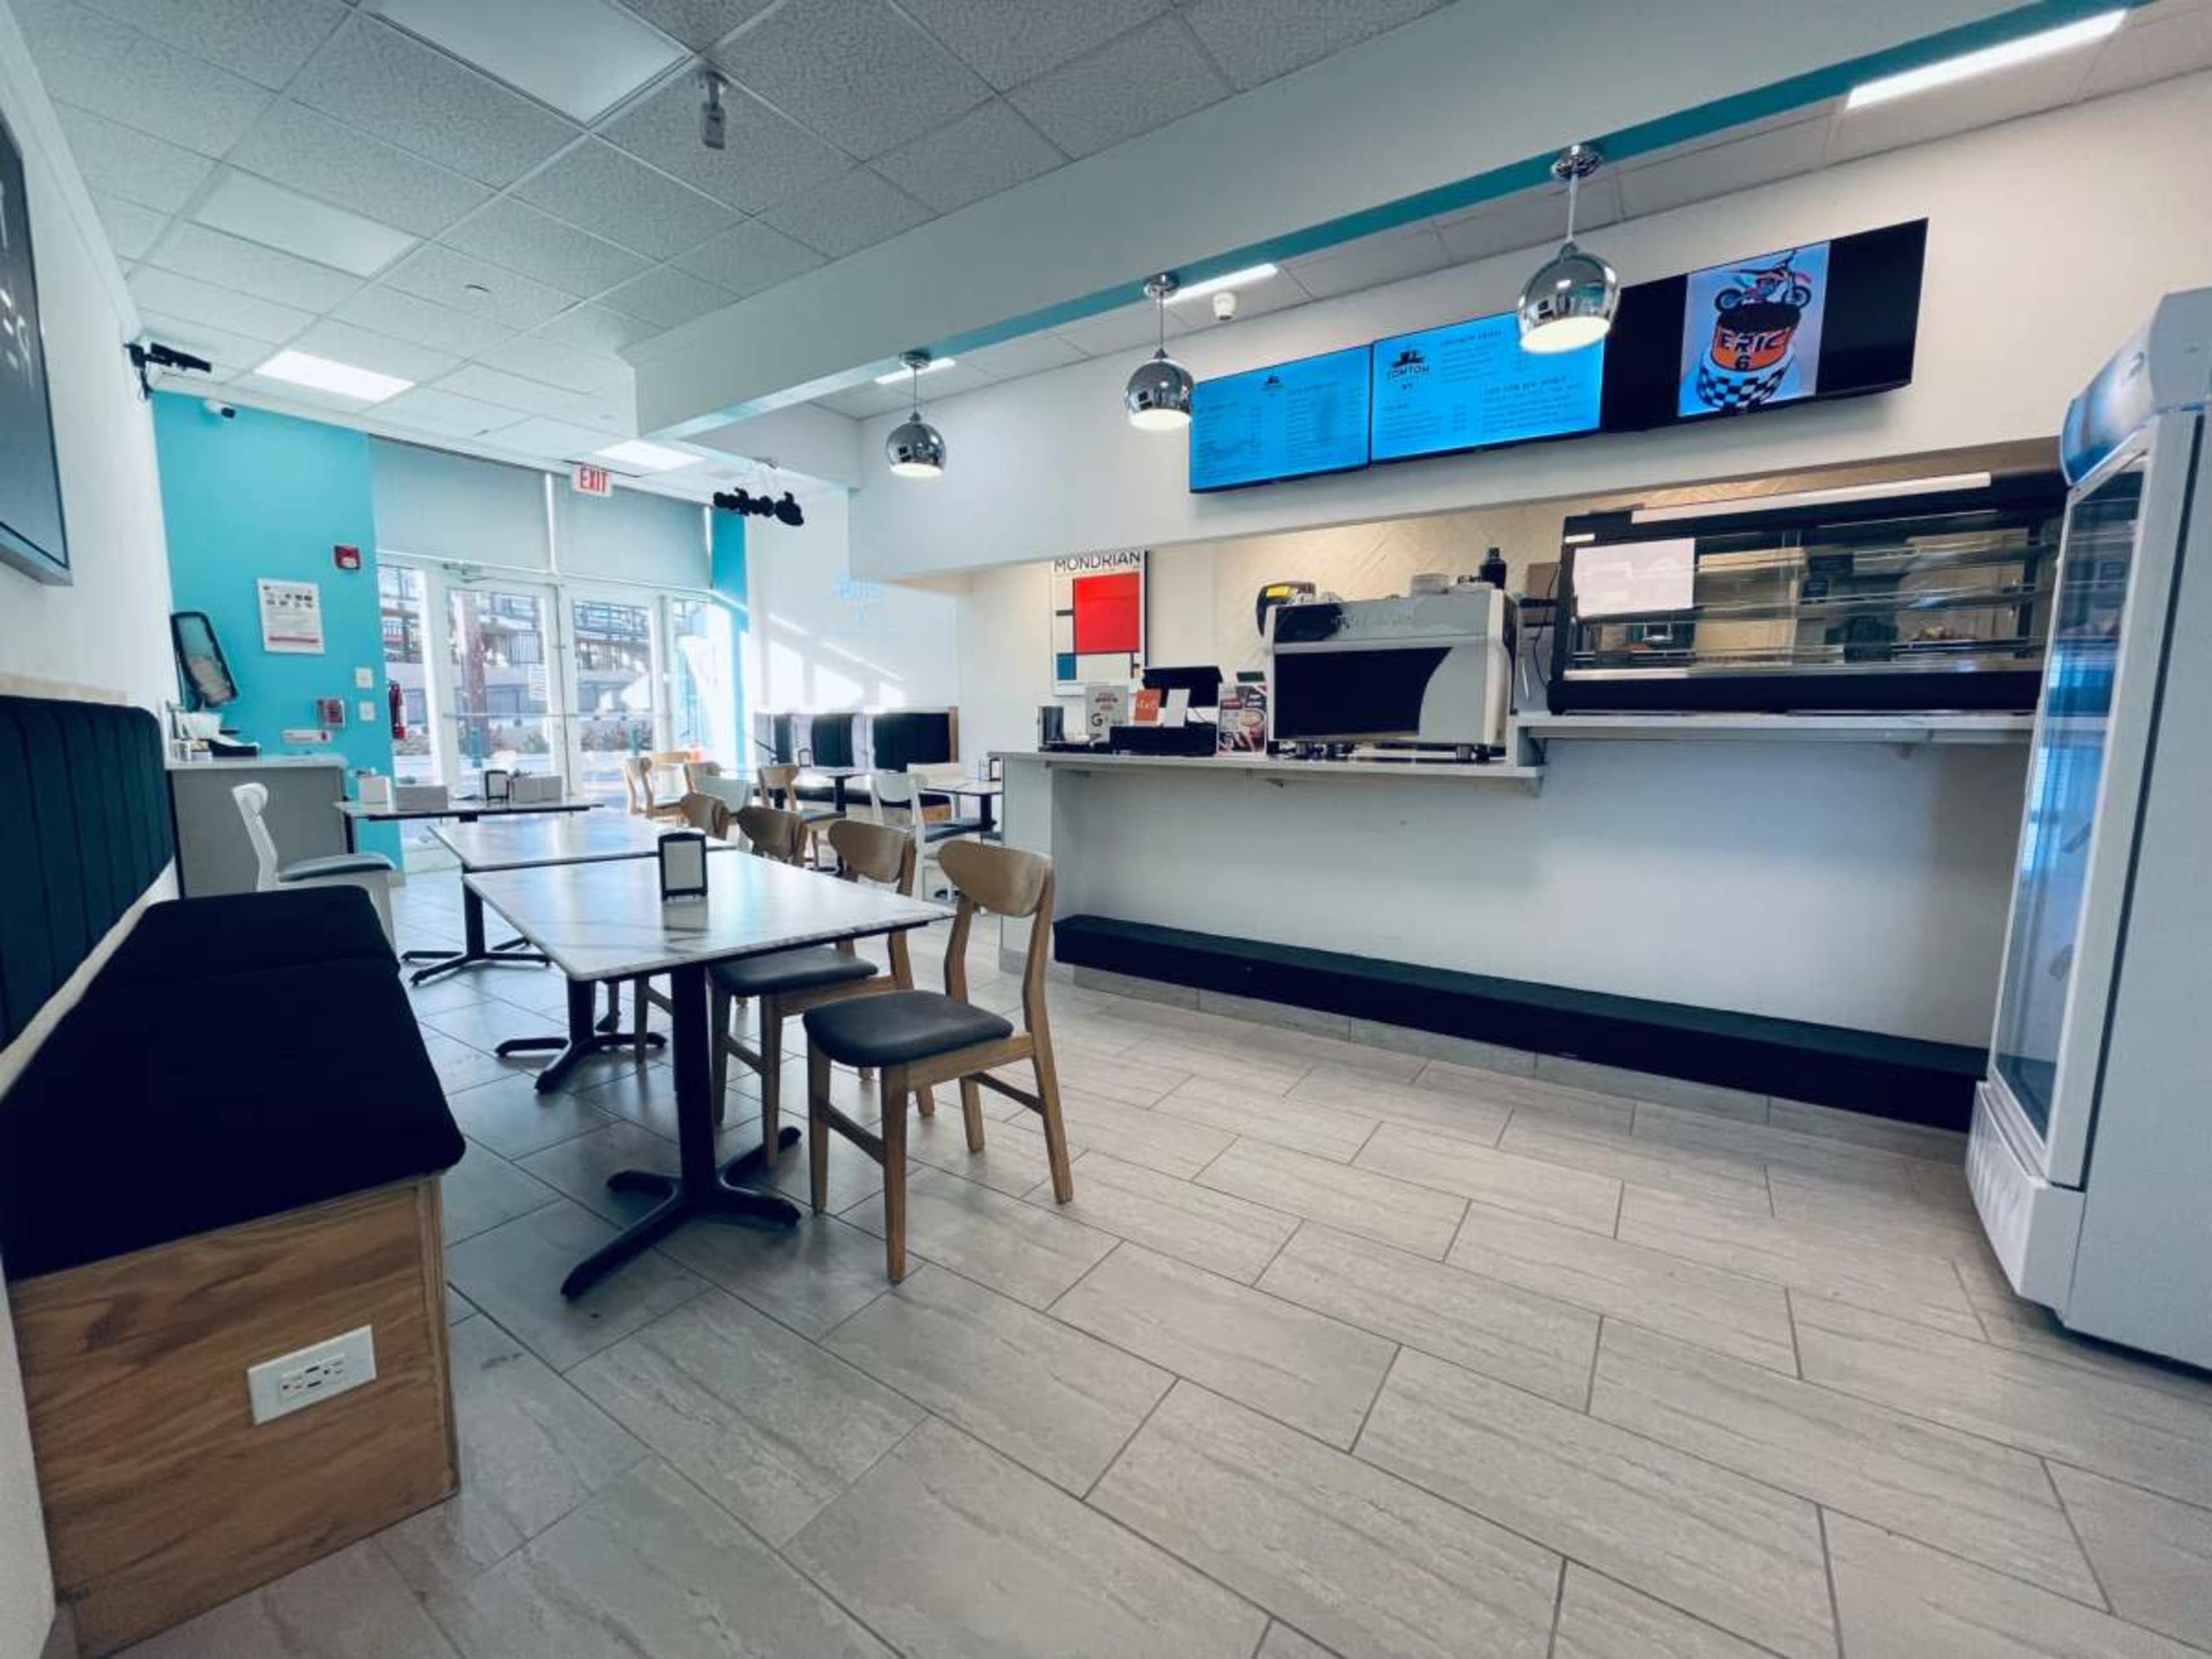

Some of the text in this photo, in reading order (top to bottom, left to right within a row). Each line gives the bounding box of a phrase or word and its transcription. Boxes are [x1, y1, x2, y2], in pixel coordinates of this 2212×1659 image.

[1721, 330, 1786, 353] ERIC
[579, 467, 608, 493] EXIT
[1054, 551, 1141, 573] MONDRIAN
